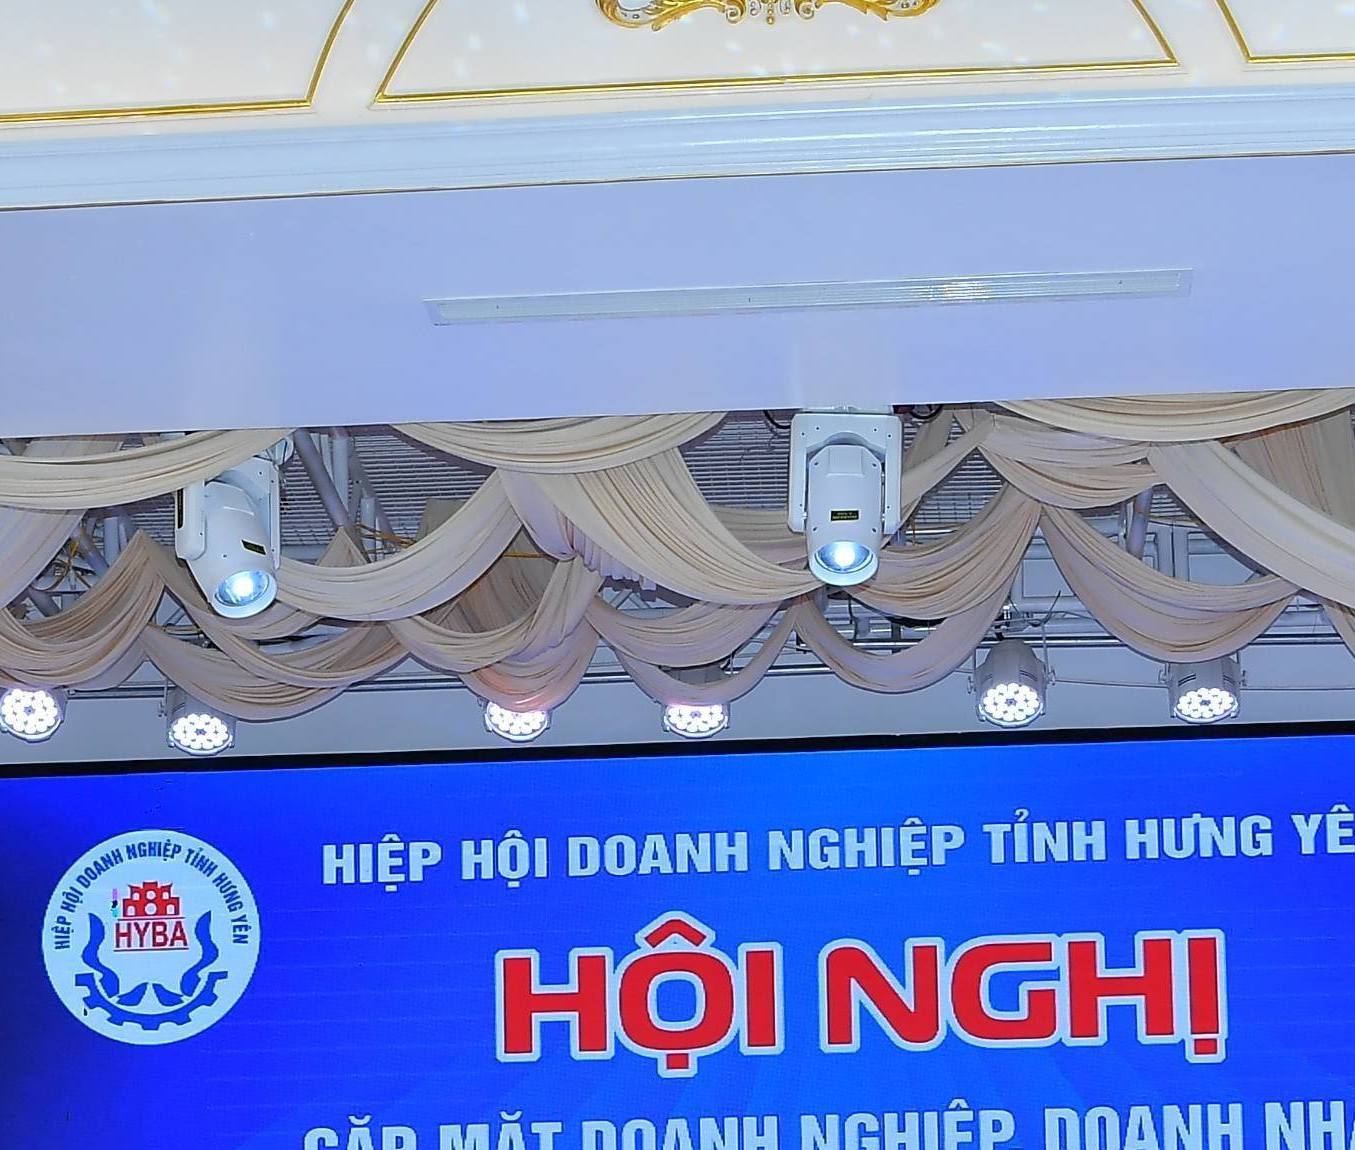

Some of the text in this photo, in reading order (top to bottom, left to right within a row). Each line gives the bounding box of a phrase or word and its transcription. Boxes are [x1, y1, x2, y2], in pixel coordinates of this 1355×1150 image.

[51, 839, 252, 950] HIỆP HỘI DOANH NGHIỆP TỈNH HƯNG YÊN
[322, 833, 442, 893] HIỆP
[461, 829, 548, 888] HỘI
[567, 830, 749, 878] DOANH
[768, 817, 965, 876] NGHIỆP
[983, 808, 1106, 864] TỈNH
[1125, 813, 1273, 860] HƯNG
[115, 920, 189, 948] HYBA
[495, 910, 1227, 1078] HỘI NGHỊ
